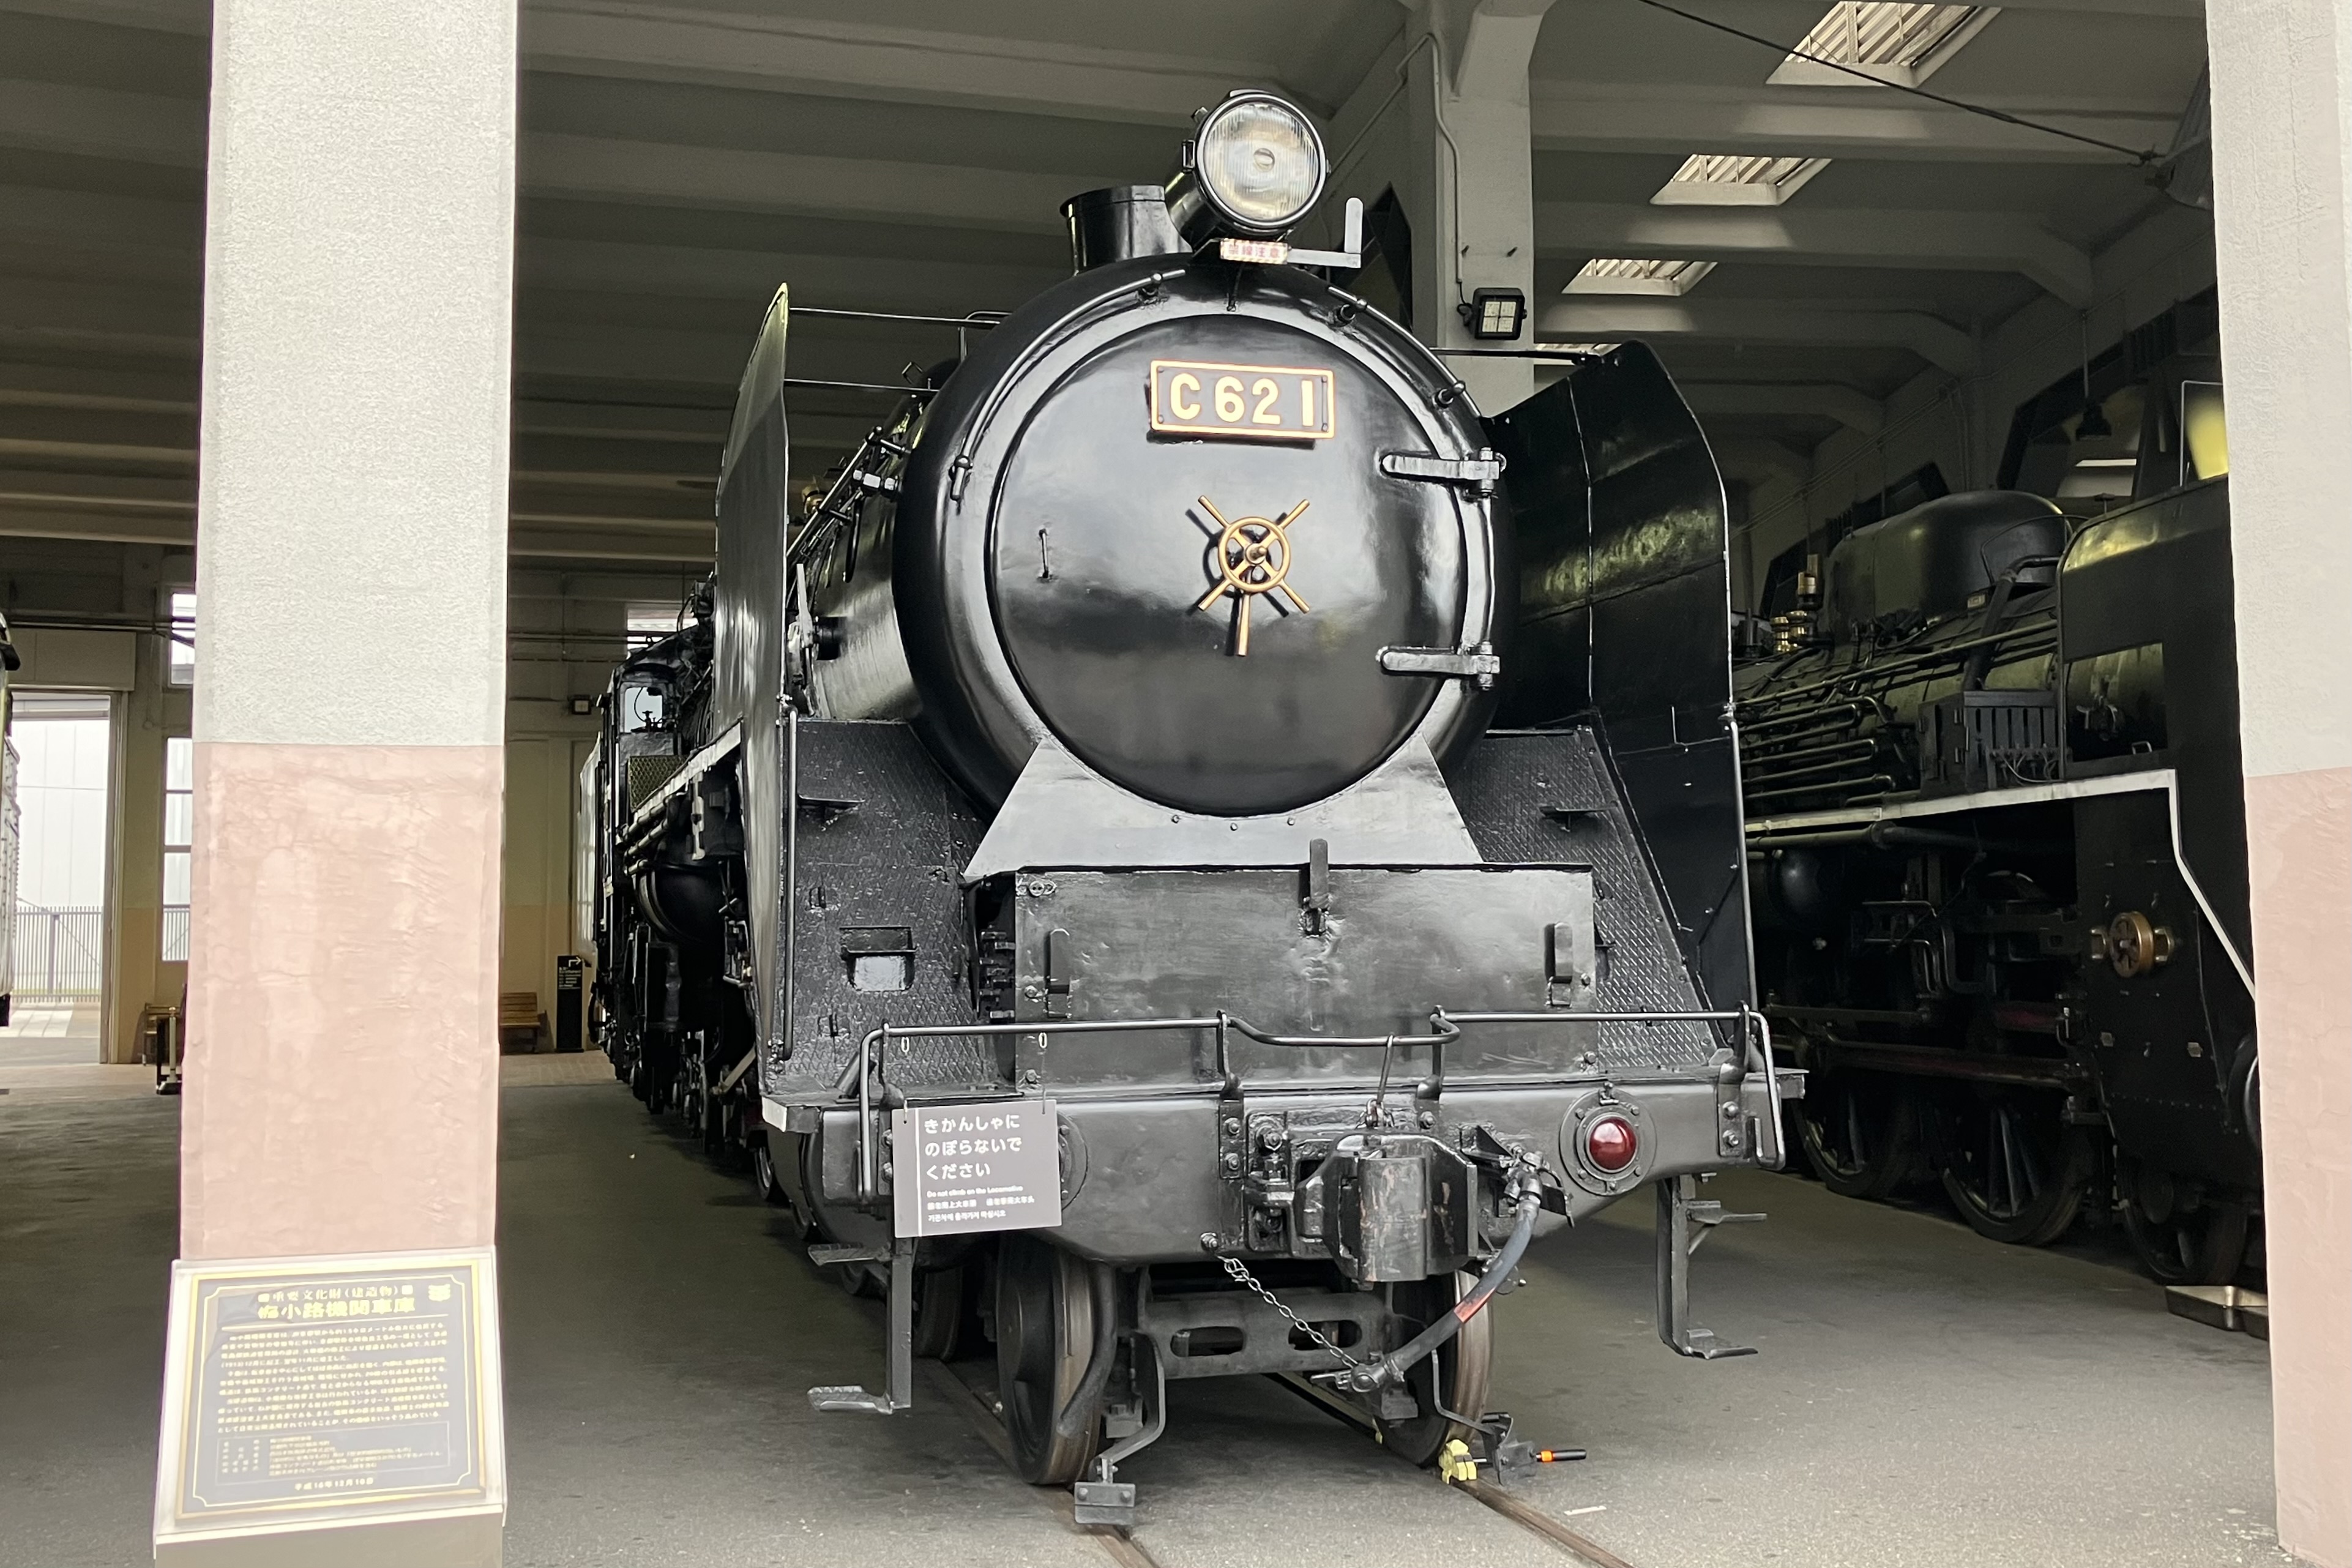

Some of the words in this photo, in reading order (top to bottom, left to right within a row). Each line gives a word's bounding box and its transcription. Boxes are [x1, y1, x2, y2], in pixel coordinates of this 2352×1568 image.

[924, 1114, 1020, 1133] きかんしゃに
[925, 1137, 1022, 1157] のぼらないで
[926, 1163, 991, 1181] ください
[987, 1185, 1024, 1193] Locomotive
